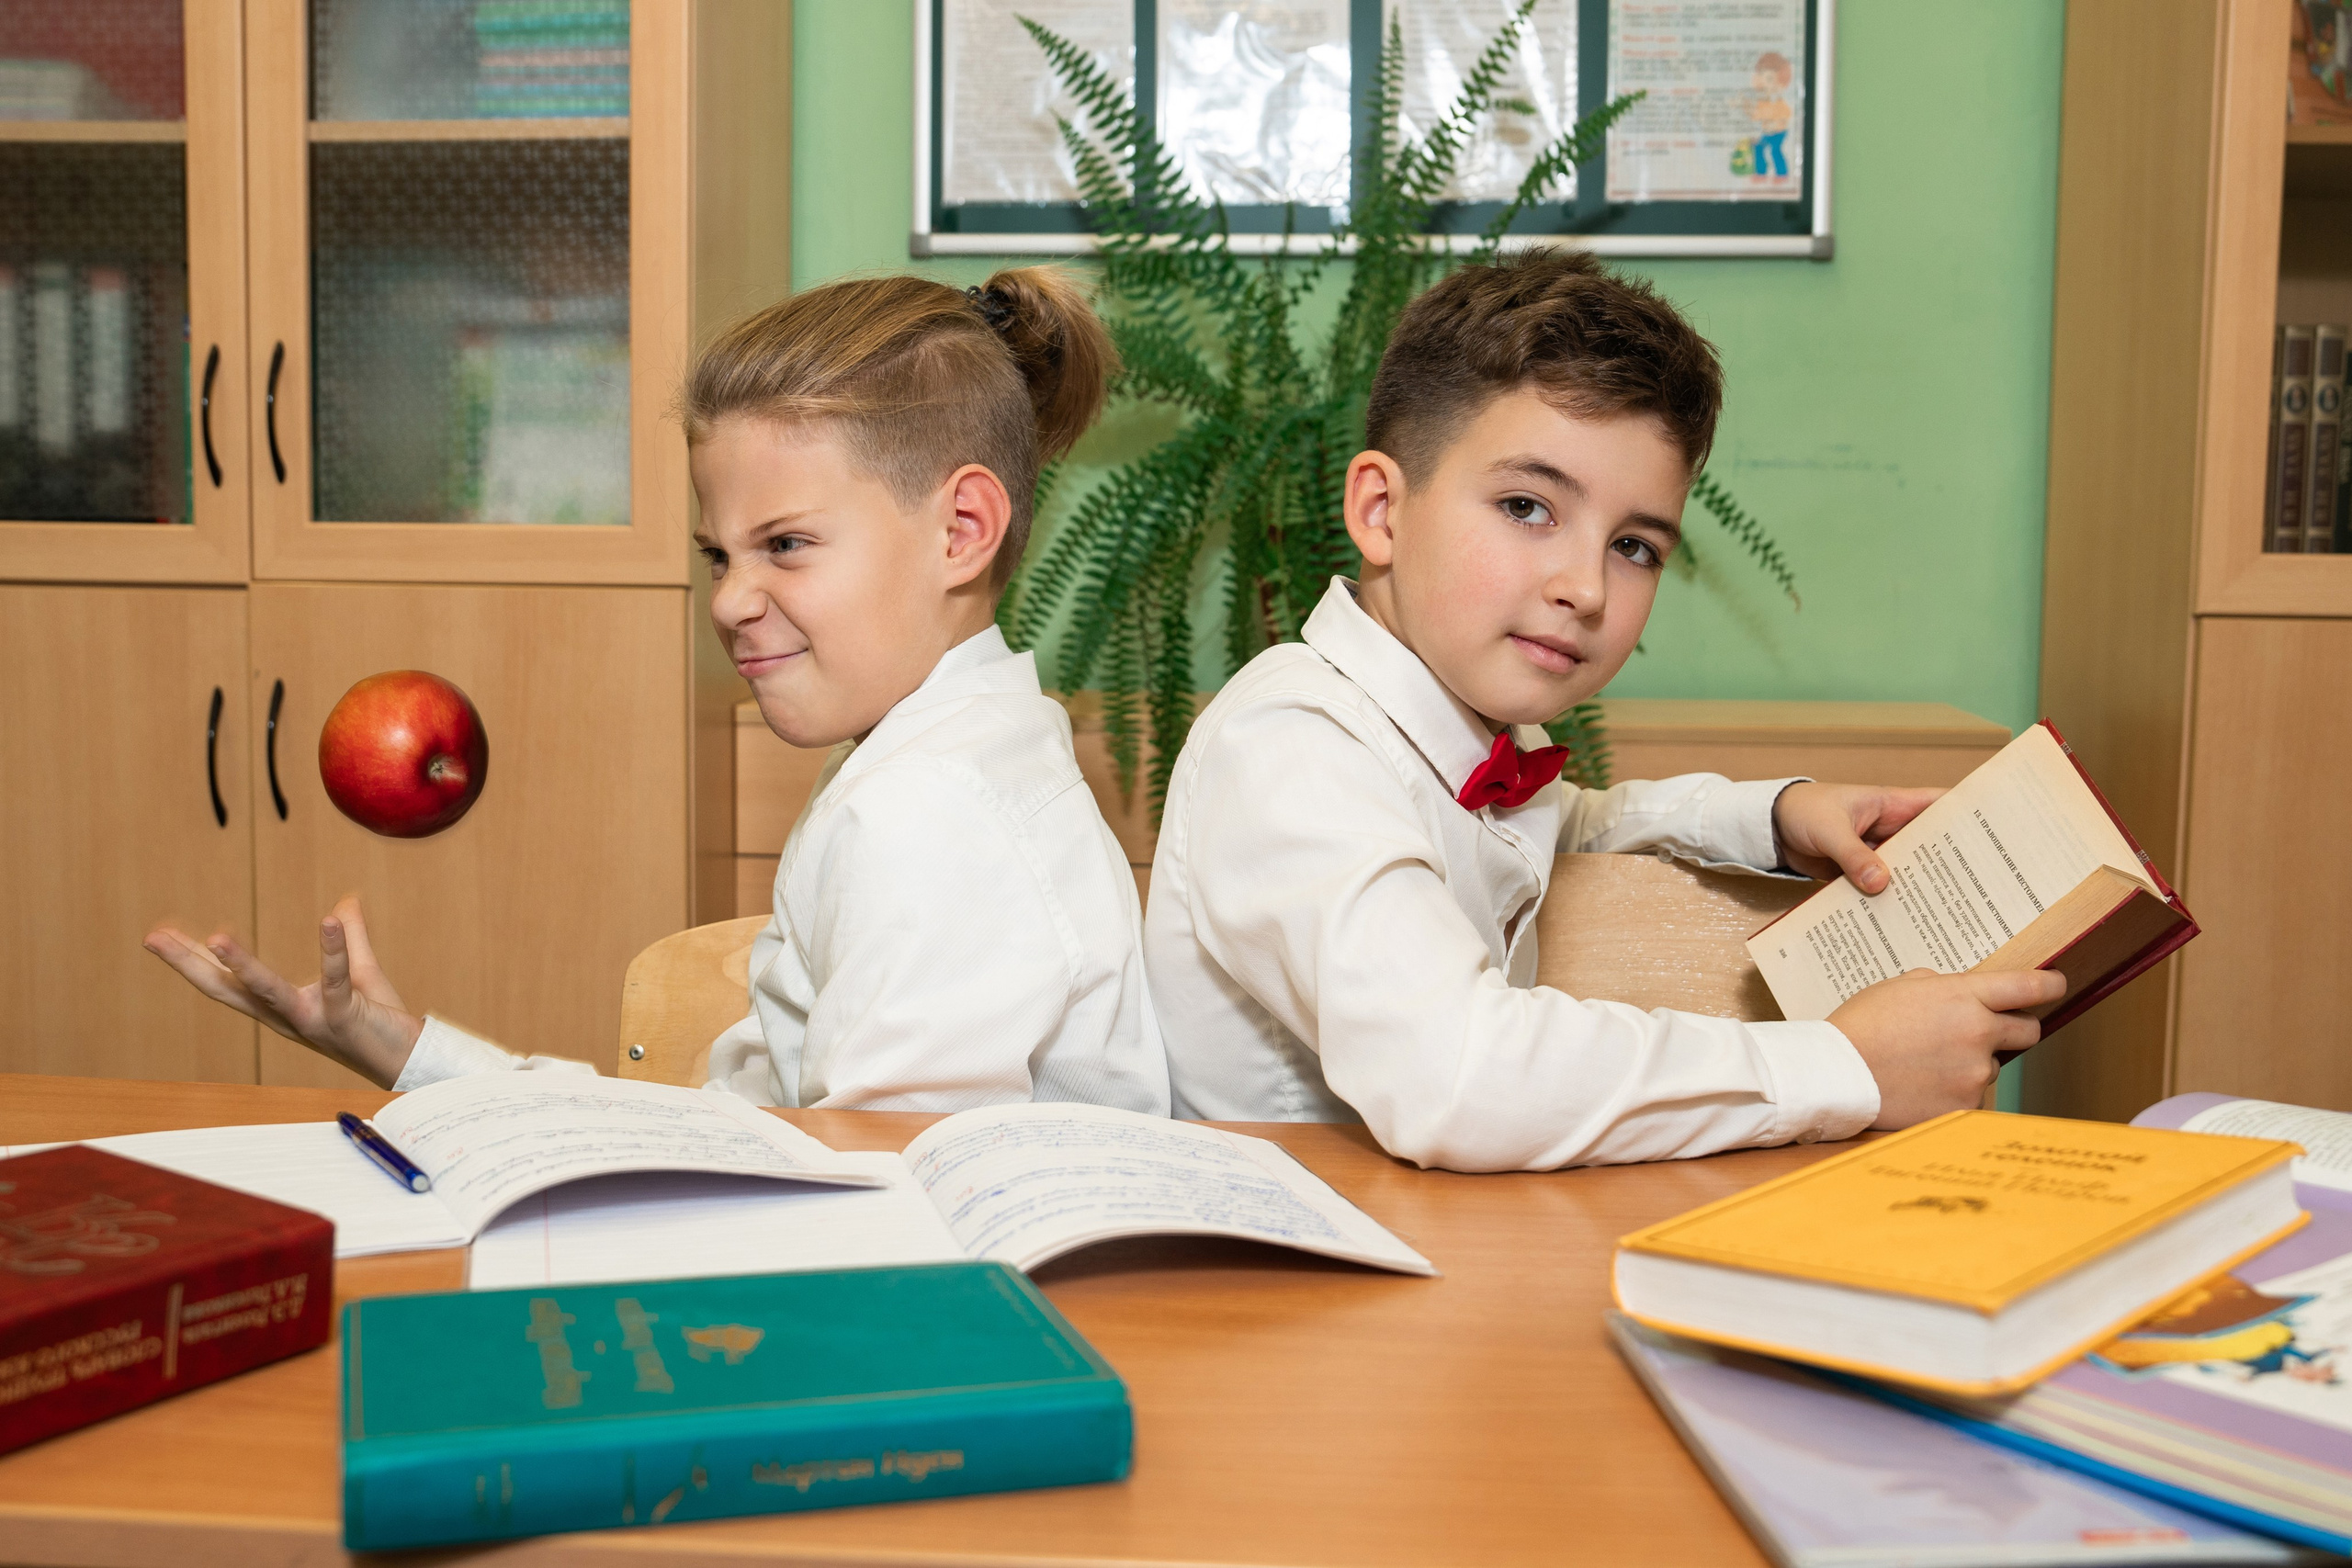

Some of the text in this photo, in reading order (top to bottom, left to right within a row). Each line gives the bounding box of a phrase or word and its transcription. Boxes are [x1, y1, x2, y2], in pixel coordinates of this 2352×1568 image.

[1911, 849, 1923, 865] кого,
[1973, 808, 1982, 820] 13.
[1979, 818, 2018, 873] ПРАВОПИСАНИЕ
[1902, 864, 1911, 874] 2.
[1906, 871, 1915, 880] В
[1942, 831, 1953, 847] 13.1.
[1951, 845, 1988, 900] ОТРИЦАТЕЛЬНЫЕ
[1893, 886, 1902, 896] ни
[1896, 894, 1905, 902] у
[1901, 899, 1912, 916] кого,
[1910, 878, 1939, 922] отрицательных
[1917, 842, 1935, 865] рением
[1931, 863, 1950, 889] пишется
[1952, 898, 1962, 911] без
[1958, 909, 1980, 939] ударения
[1930, 842, 1999, 952] 1. В отрицательных местоимениях по
[1826, 913, 1841, 934] шутся
[1838, 931, 1850, 950] через
[1845, 908, 1875, 956] Неопределенные
[1892, 865, 1958, 972] явлении предлога образуется сочетание
[1909, 913, 1917, 924] ни
[1917, 927, 1928, 942] чем,
[1812, 923, 1851, 990] имения предлогом, то
[1846, 928, 1870, 966] постфиксами
[1867, 911, 1902, 969] НЕОПРЕДЕЛЕННЫЕ
[1925, 941, 1933, 951] не
[1935, 920, 1964, 964] местоимениях
[1804, 929, 1815, 942] три
[1811, 941, 1826, 962] слова:
[1822, 961, 1832, 973] кое
[1830, 977, 1842, 995] кого,
[1839, 953, 1851, 972] Если
[1849, 972, 1859, 984] кое
[1932, 954, 1944, 970] кем.
